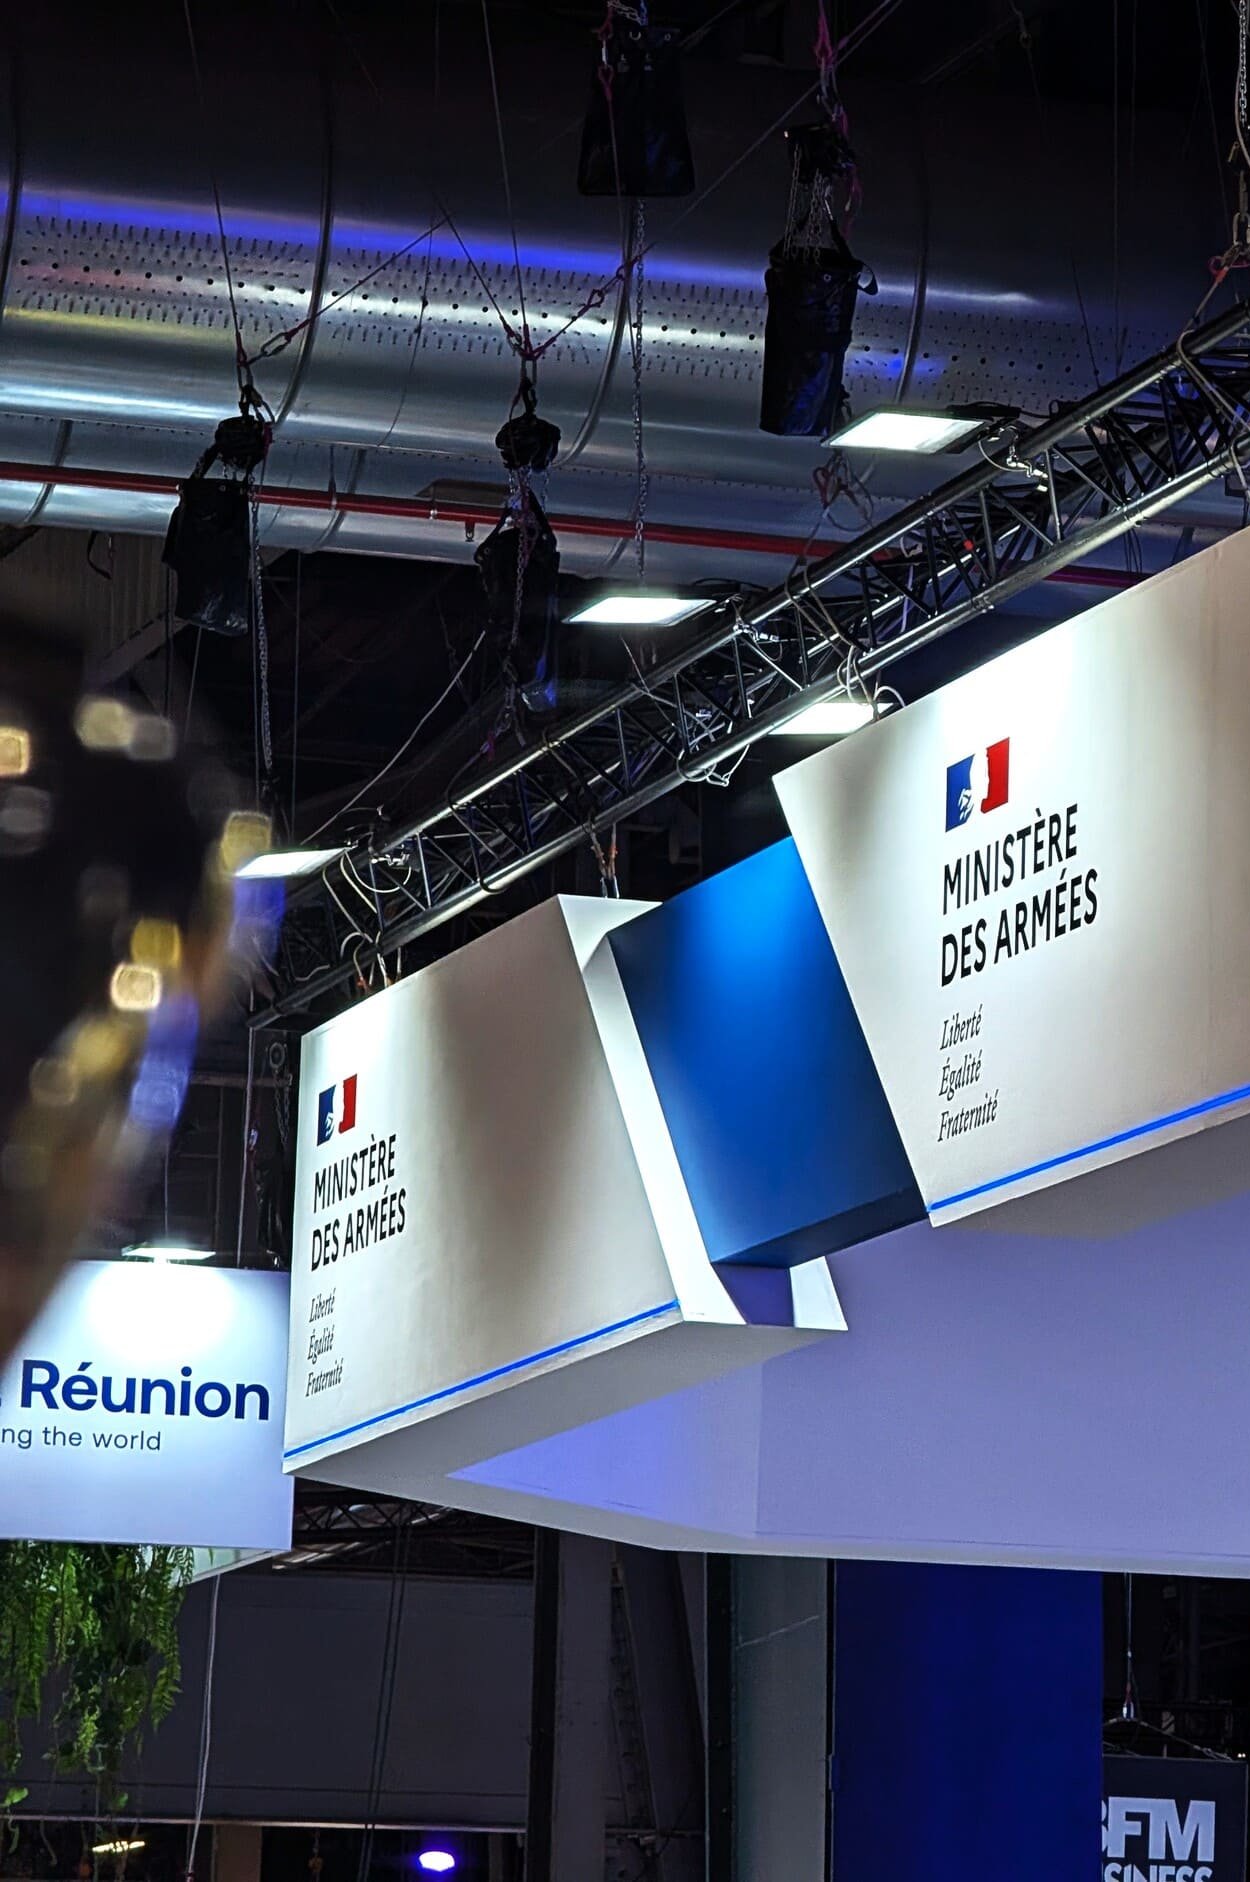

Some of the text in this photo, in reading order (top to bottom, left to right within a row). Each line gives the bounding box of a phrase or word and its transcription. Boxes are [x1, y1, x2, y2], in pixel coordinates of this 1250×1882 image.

[943, 803, 1078, 915] MINISTÈRE
[941, 868, 1098, 988] DES ARMÉES
[940, 1004, 983, 1051] Liberté
[938, 1049, 982, 1101] Égalité
[937, 1089, 999, 1143] Fraternité
[313, 1133, 397, 1214] MINISTÈRE
[311, 1186, 407, 1272] DES ARMÉES
[309, 1288, 336, 1323] Liberté
[307, 1325, 335, 1364] Égalité
[20, 1359, 270, 1421] Réunion
[305, 1358, 344, 1397] Fraternité
[42, 1425, 82, 1447] the
[92, 1431, 161, 1451] world
